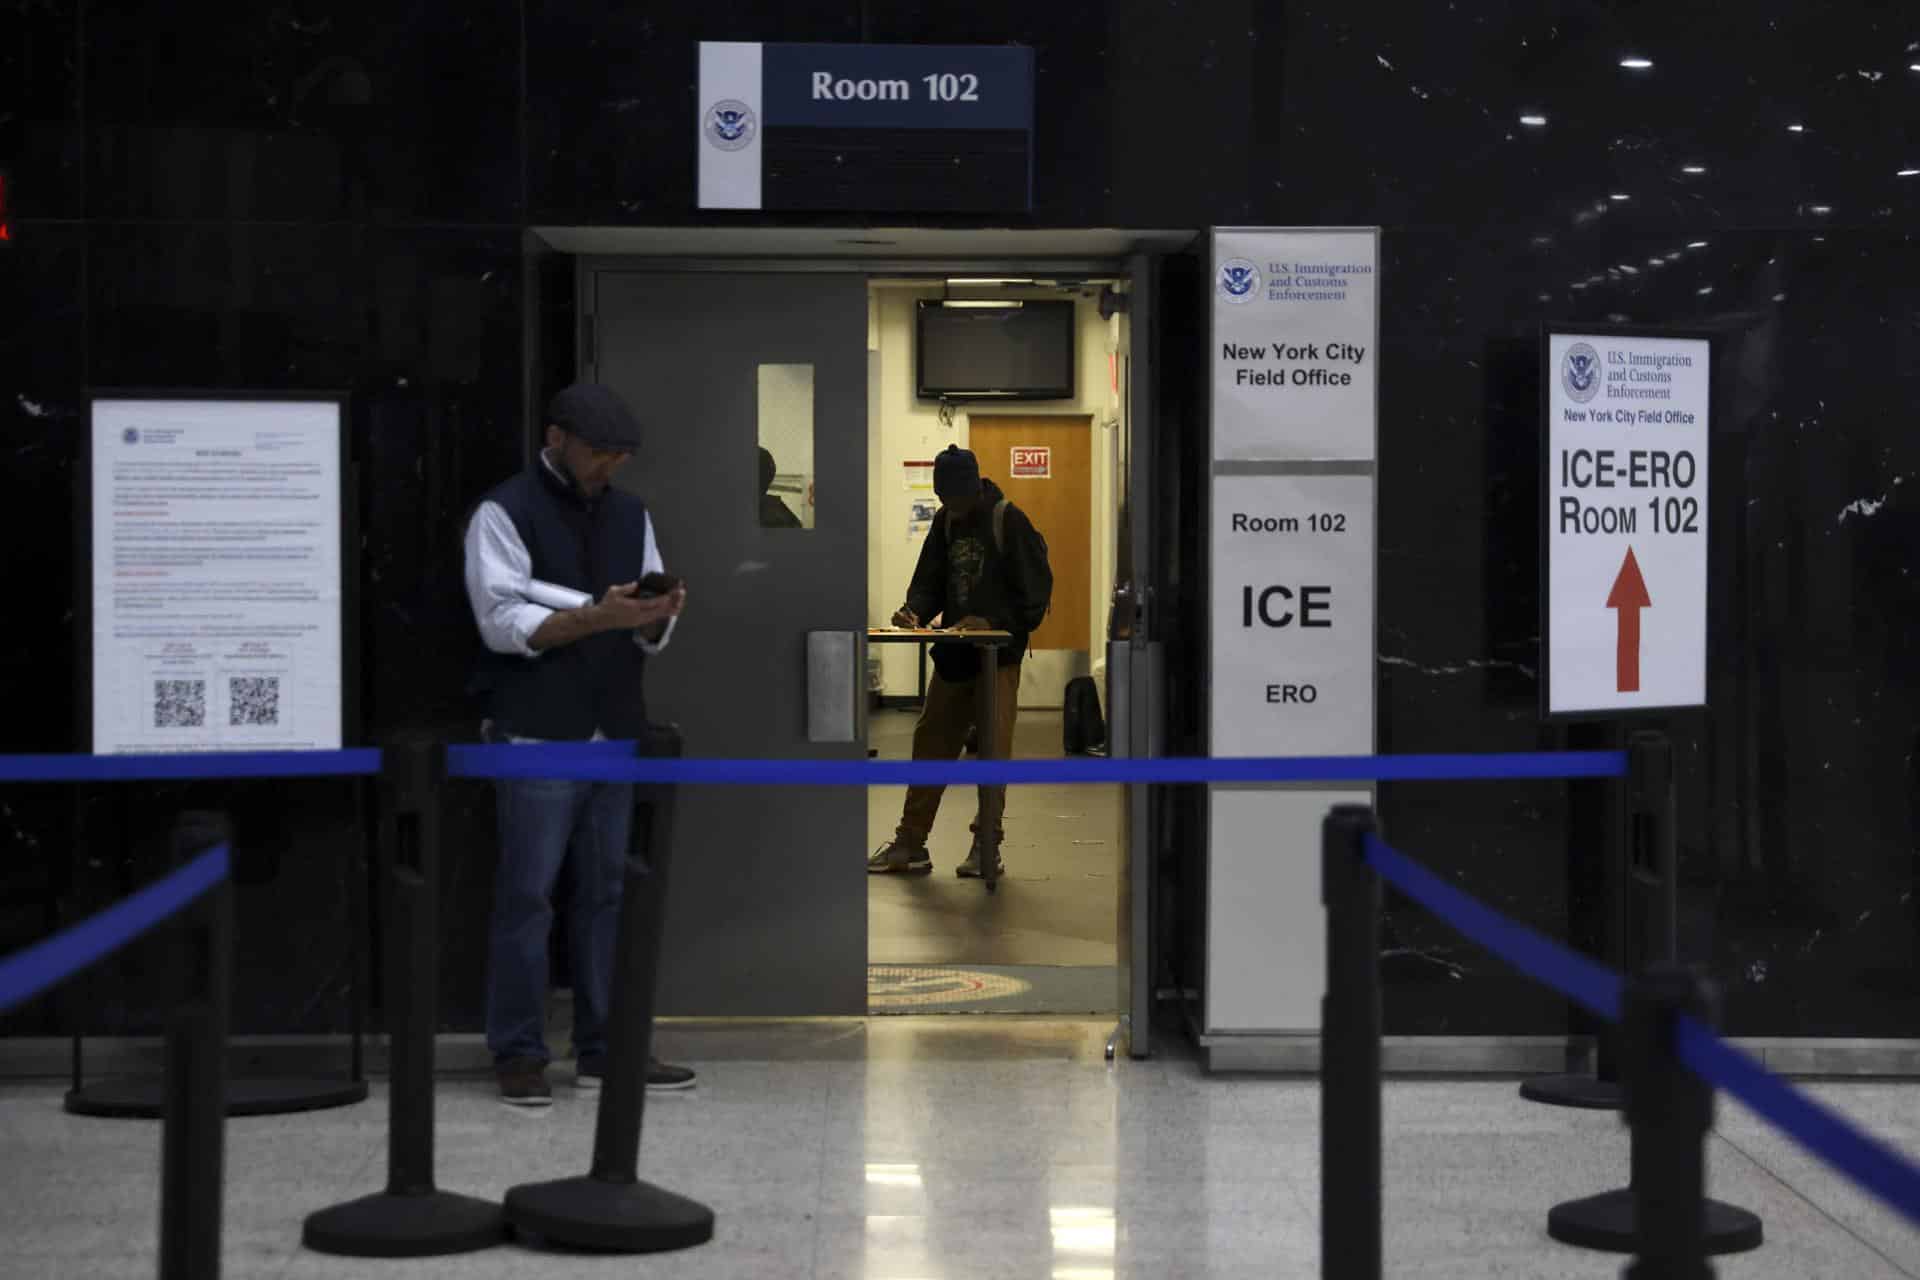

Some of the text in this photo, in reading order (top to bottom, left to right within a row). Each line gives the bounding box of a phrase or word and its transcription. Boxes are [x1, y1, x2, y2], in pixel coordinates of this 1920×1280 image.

[811, 71, 979, 101] Room 102
[1294, 263, 1372, 277] Immigration
[1268, 276, 1348, 288] and Customs
[1268, 288, 1345, 301] Enforcement
[1223, 343, 1365, 364] New York City
[1607, 351, 1692, 369] U.S. Immigration
[1236, 369, 1352, 386] Field Office
[1607, 368, 1672, 383] and Customs
[1607, 384, 1671, 399] Enforcement
[1564, 408, 1695, 427] New York City Field Office
[1015, 452, 1049, 465] EXIT
[1562, 448, 1696, 489] ICE-ERO
[1232, 513, 1346, 532] Room 102
[1649, 496, 1698, 534] 102
[1243, 585, 1332, 628] ICE
[1266, 684, 1317, 703] ERO
